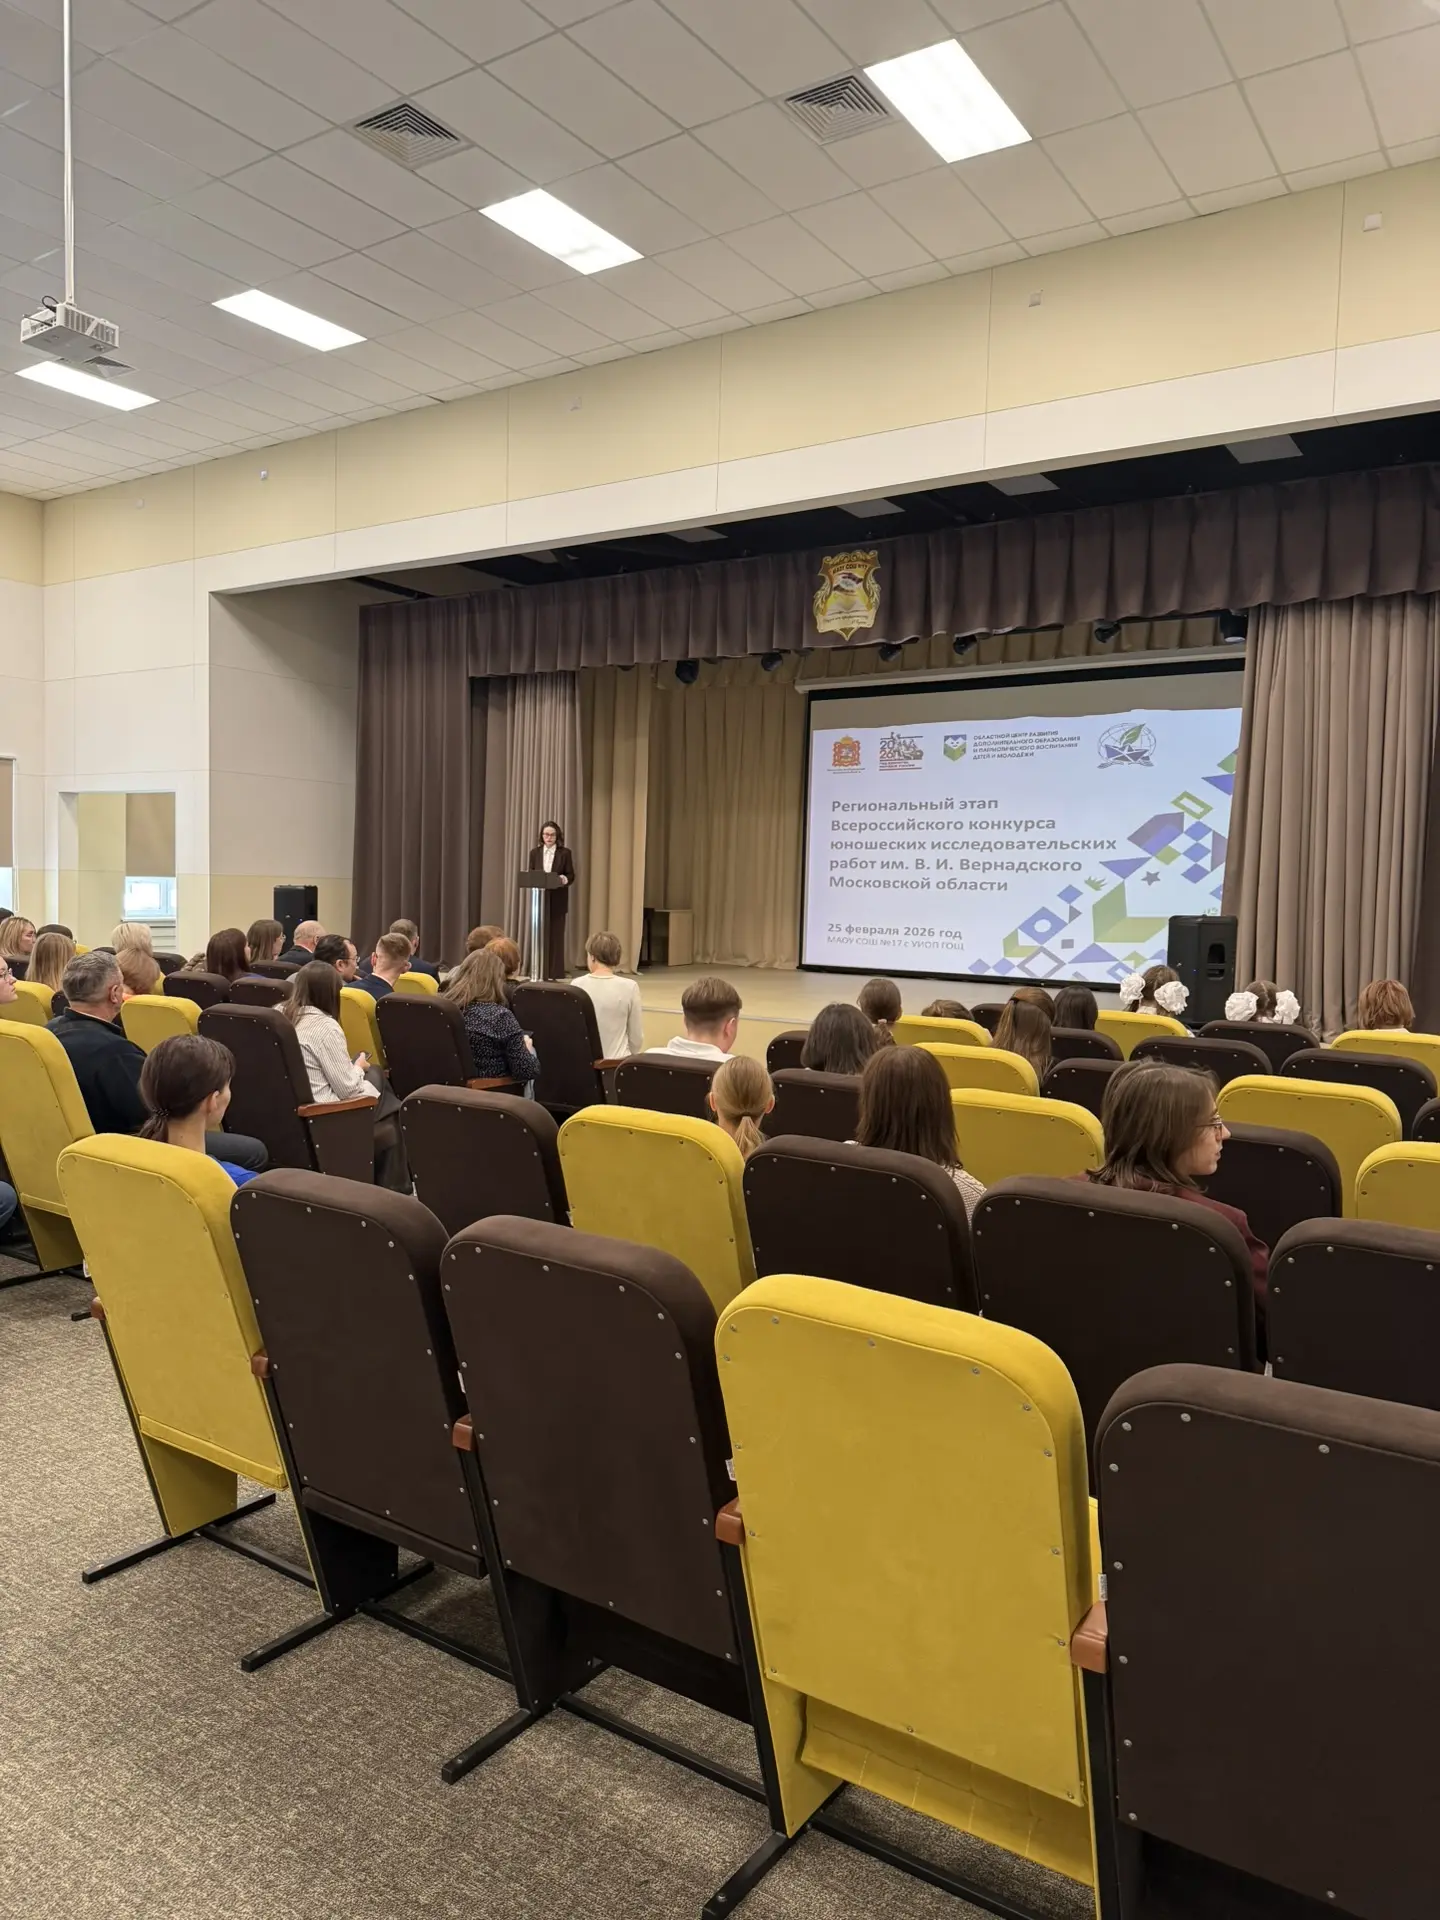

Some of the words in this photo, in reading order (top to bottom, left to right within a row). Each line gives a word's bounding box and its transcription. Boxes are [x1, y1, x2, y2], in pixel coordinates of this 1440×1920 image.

[973, 733, 1010, 741] ОБЛАСТНОЙ
[973, 738, 1034, 747] ДОПОЛНИТЕЛЬНОГО
[832, 798, 954, 813] Региональный
[959, 799, 998, 810] этап
[831, 819, 963, 833] Всероссийского
[969, 819, 1056, 832] конкурса
[830, 840, 926, 850] юношеских
[931, 839, 1117, 852] исследовательских
[829, 857, 876, 871] работ
[881, 862, 909, 870] им.
[915, 858, 930, 870] В.
[936, 858, 953, 870] И.
[959, 858, 1082, 873] Вернадского
[829, 876, 931, 890] Московской
[936, 877, 1008, 891] области
[828, 923, 842, 932] 25
[845, 924, 899, 935] февраля
[904, 927, 935, 937] 2026
[940, 930, 963, 940] год
[827, 935, 854, 944] МАОУ
[856, 937, 878, 946] СОШ
[880, 939, 902, 947] №17
[912, 940, 939, 949] УИОП
